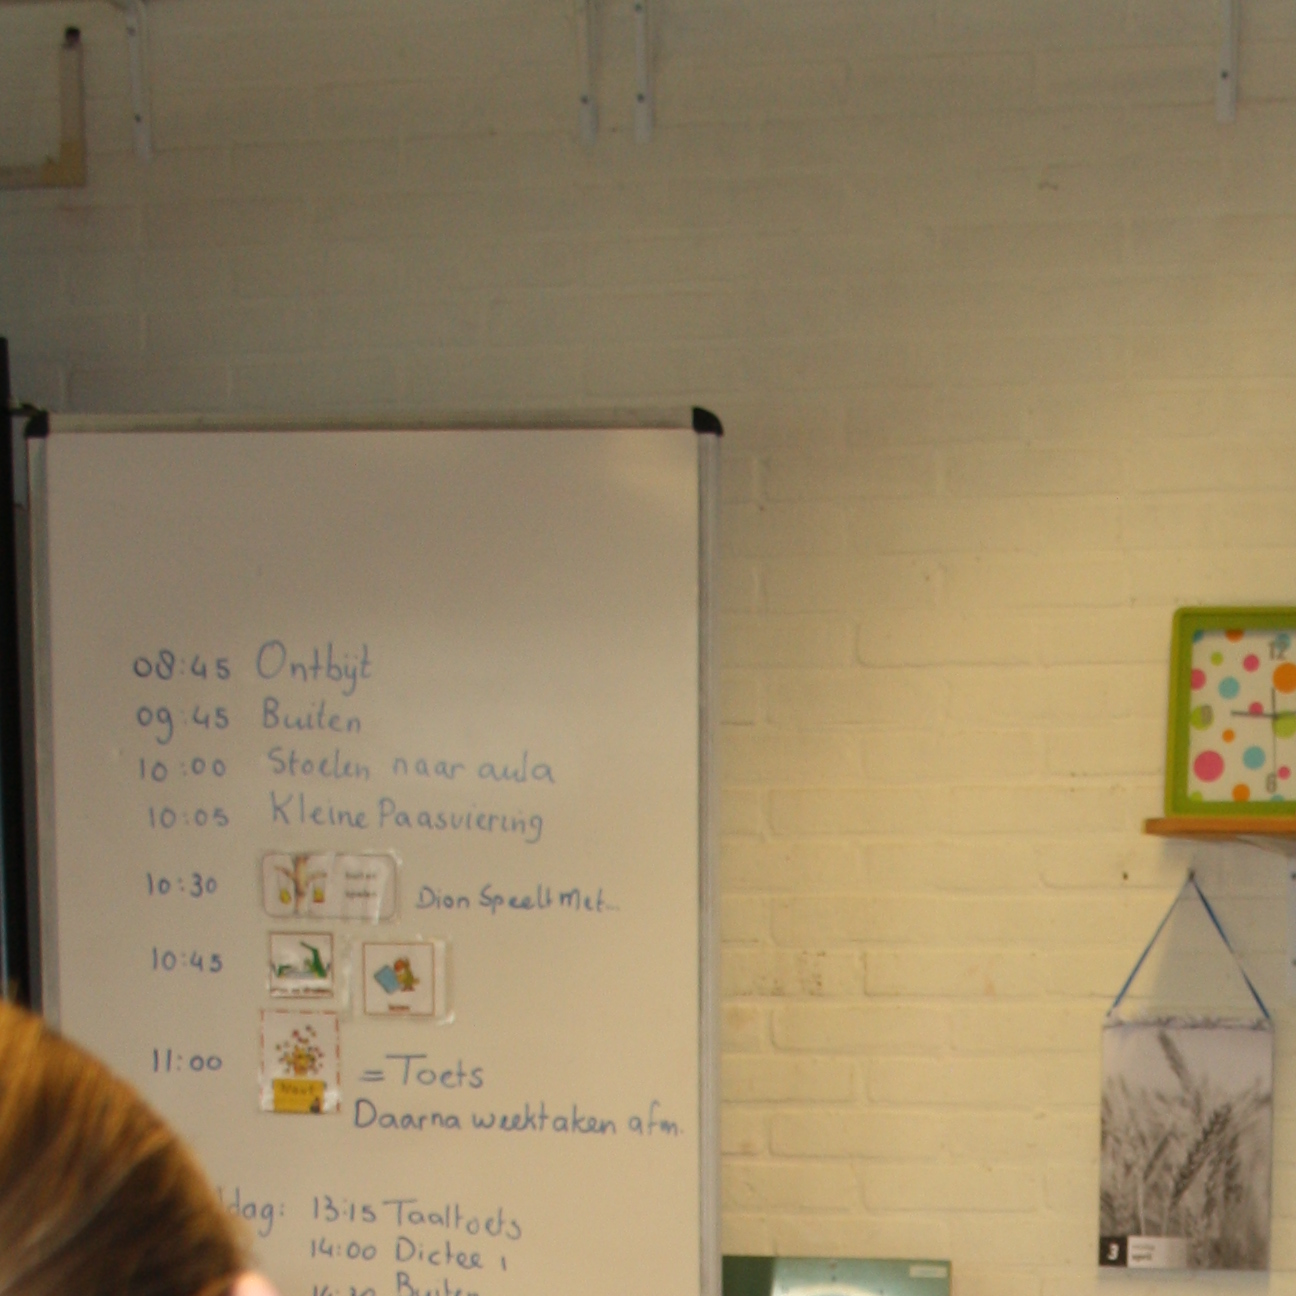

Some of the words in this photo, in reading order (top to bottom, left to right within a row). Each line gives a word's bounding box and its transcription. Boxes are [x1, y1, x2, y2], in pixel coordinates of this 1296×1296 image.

[133, 649, 231, 681] 08:45
[1269, 640, 1288, 660] 12
[136, 705, 230, 744] 09:45
[262, 697, 362, 734] Buiten
[139, 757, 227, 782] 10:00
[267, 746, 370, 782] Stoelen
[392, 756, 465, 780] naar
[477, 751, 556, 784] aula
[148, 807, 231, 829] 10:05
[269, 789, 369, 830] Kleine
[378, 795, 544, 844] Paasviering
[145, 872, 219, 897] 10:30
[415, 884, 471, 910] Dion
[151, 946, 224, 974] 10:45
[152, 1048, 223, 1073] 11:00
[353, 1097, 461, 1131] Daarna
[471, 1102, 616, 1135] weektaken
[312, 1195, 378, 1223] 13:15
[382, 1198, 524, 1240] Taaltoets
[310, 1239, 378, 1261] 14:00
[395, 1236, 484, 1270] Dictee
